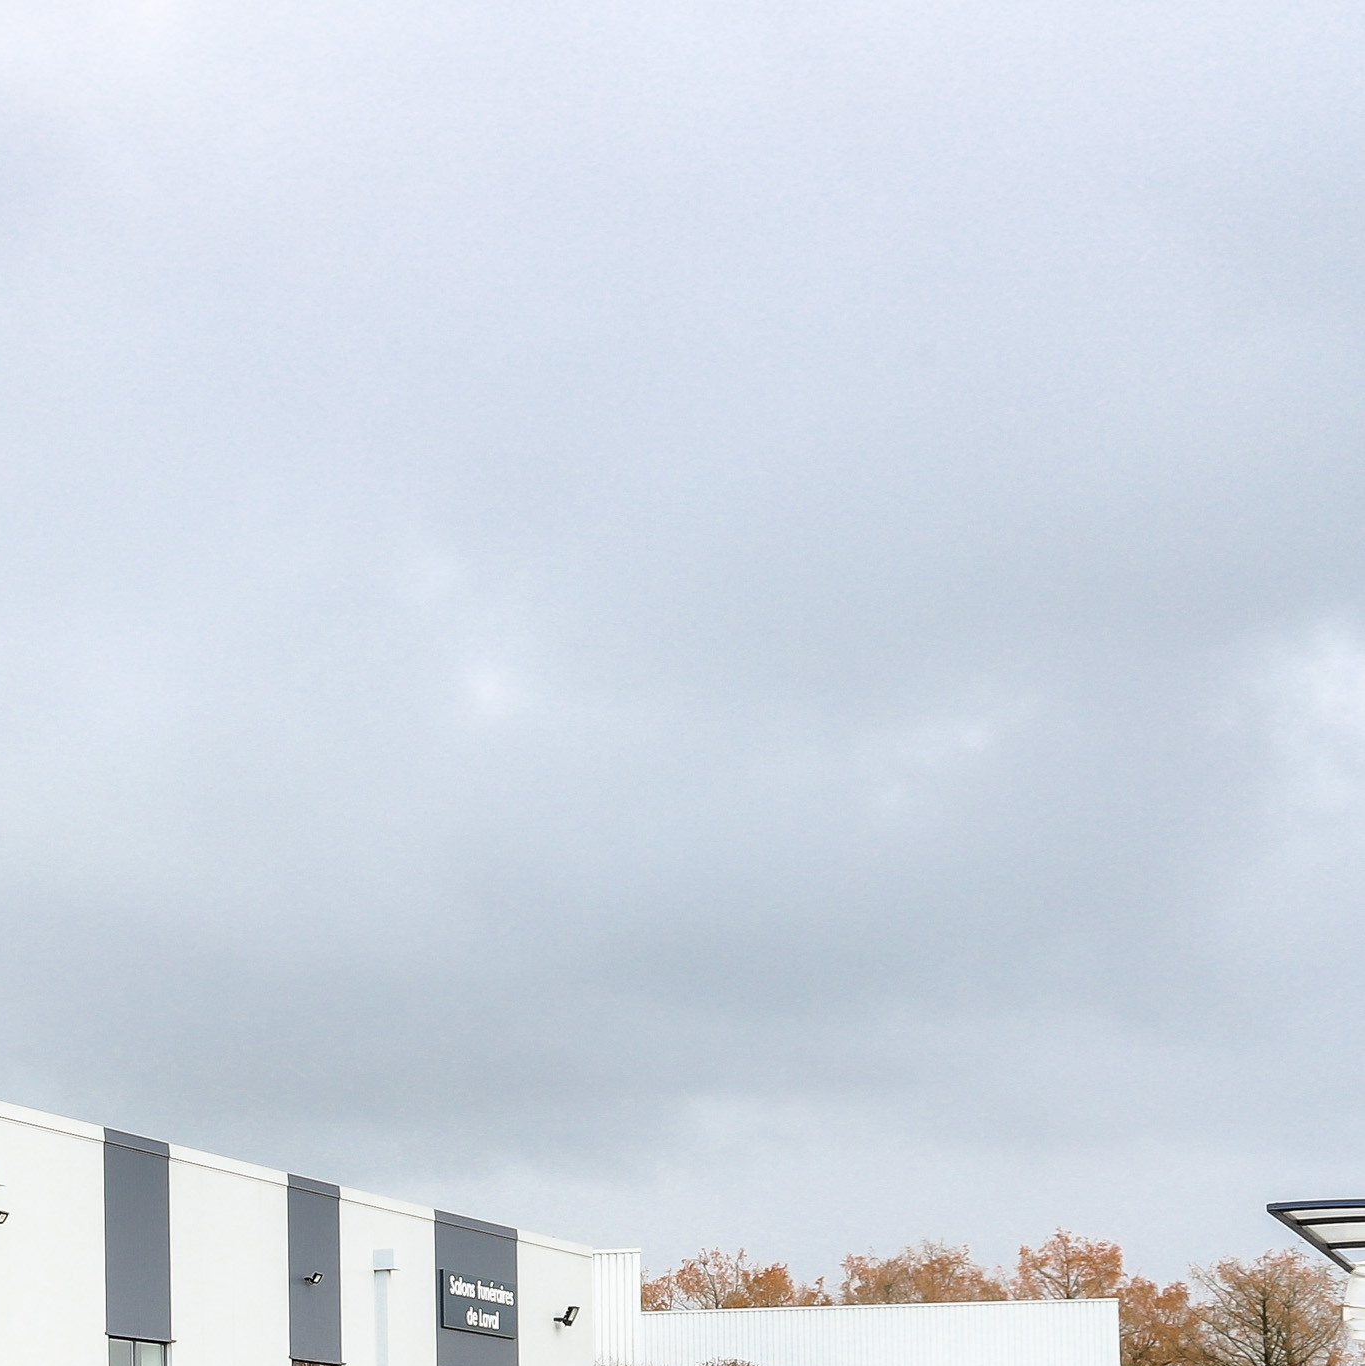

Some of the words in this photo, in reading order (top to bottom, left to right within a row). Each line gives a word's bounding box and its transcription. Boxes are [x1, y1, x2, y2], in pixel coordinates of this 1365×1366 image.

[449, 1275, 476, 1298] Salons
[476, 1280, 514, 1306] funéraires
[466, 1306, 478, 1326] de
[478, 1308, 500, 1330] Laval
